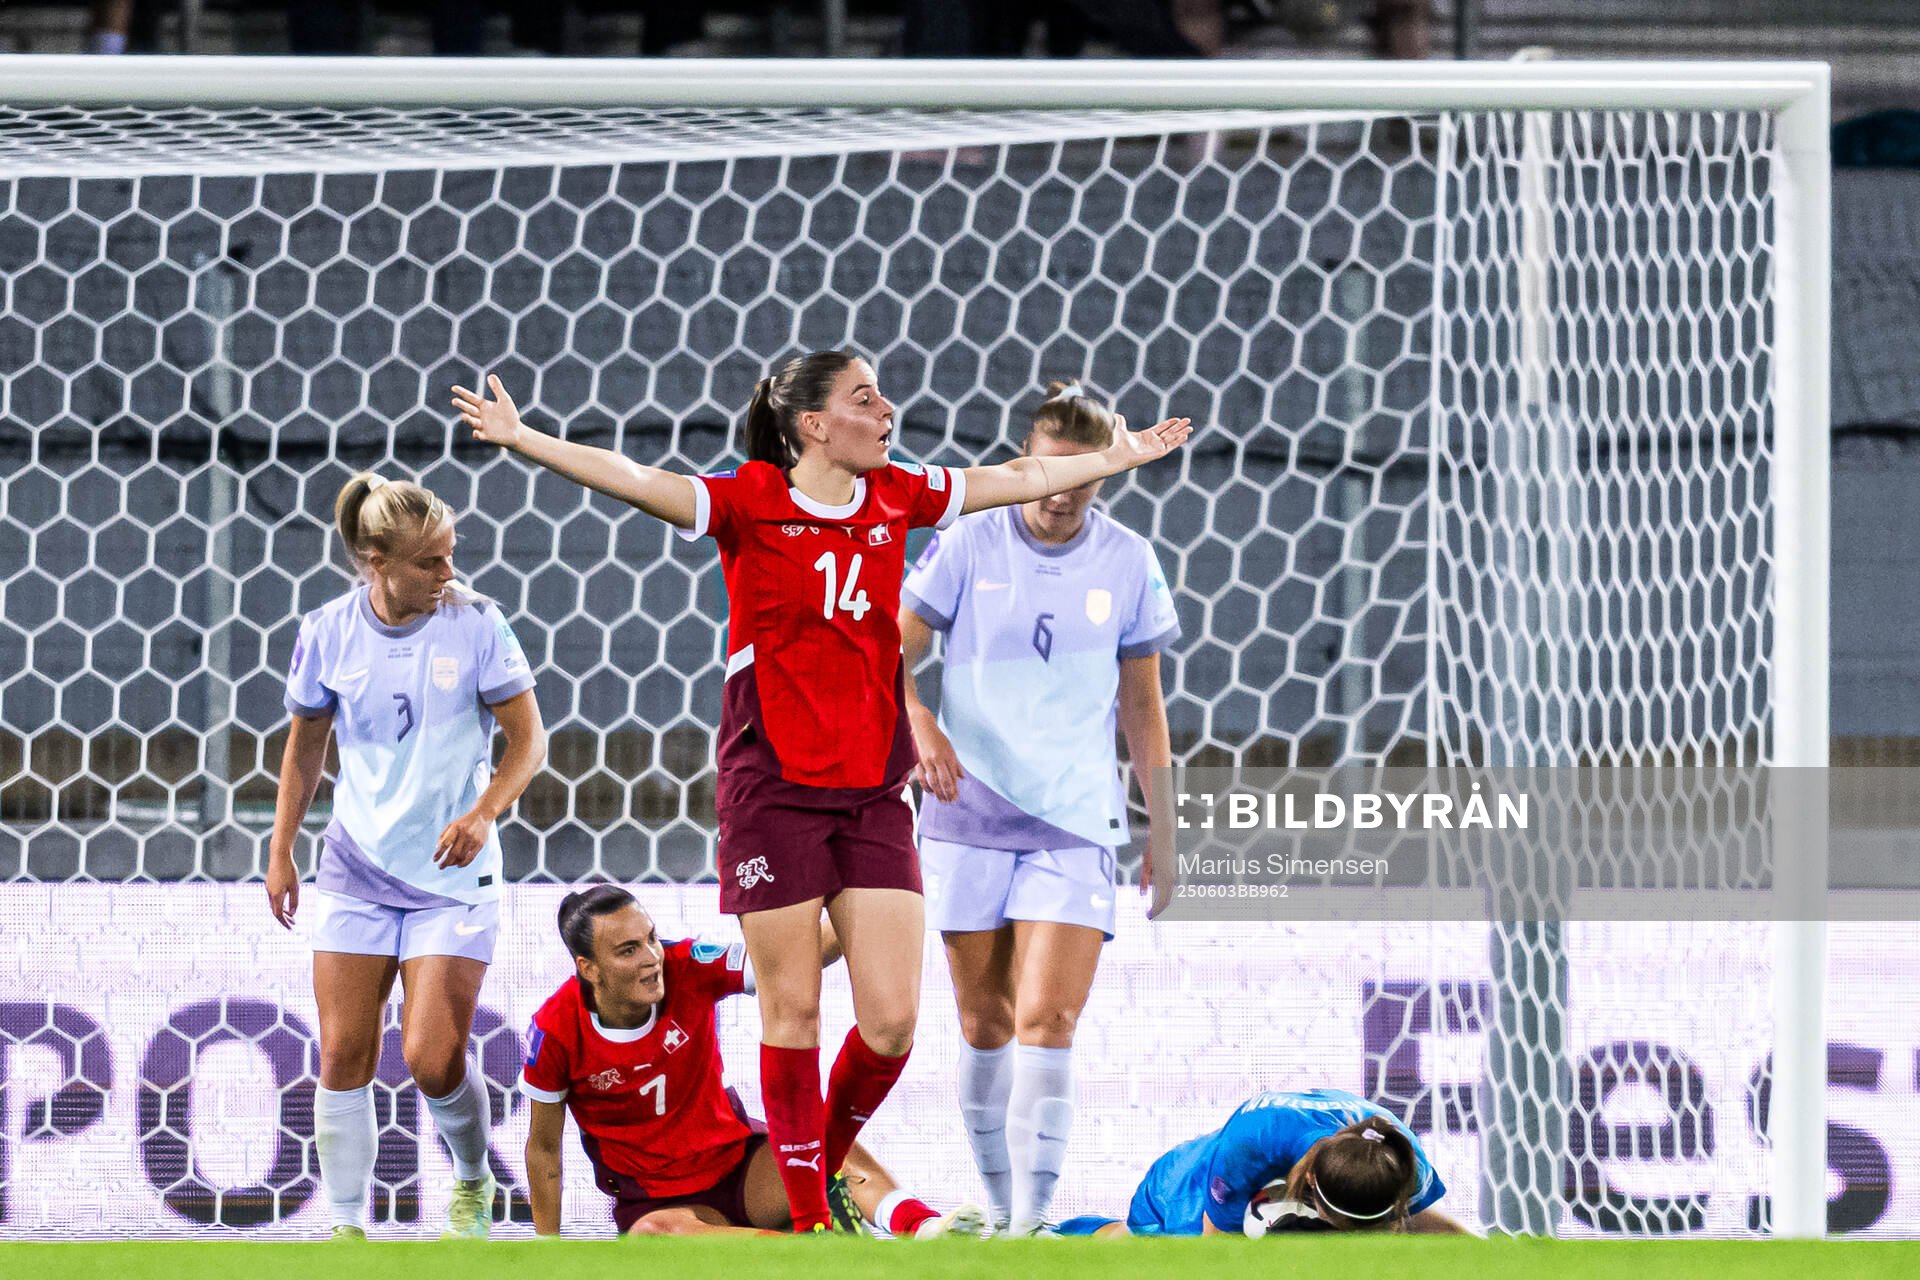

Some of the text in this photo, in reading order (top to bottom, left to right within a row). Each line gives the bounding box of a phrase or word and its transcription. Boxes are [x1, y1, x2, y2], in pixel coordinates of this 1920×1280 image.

[813, 551, 872, 622] 14
[1032, 611, 1055, 663] 6
[393, 692, 415, 744] 3
[639, 1074, 667, 1116] 7
